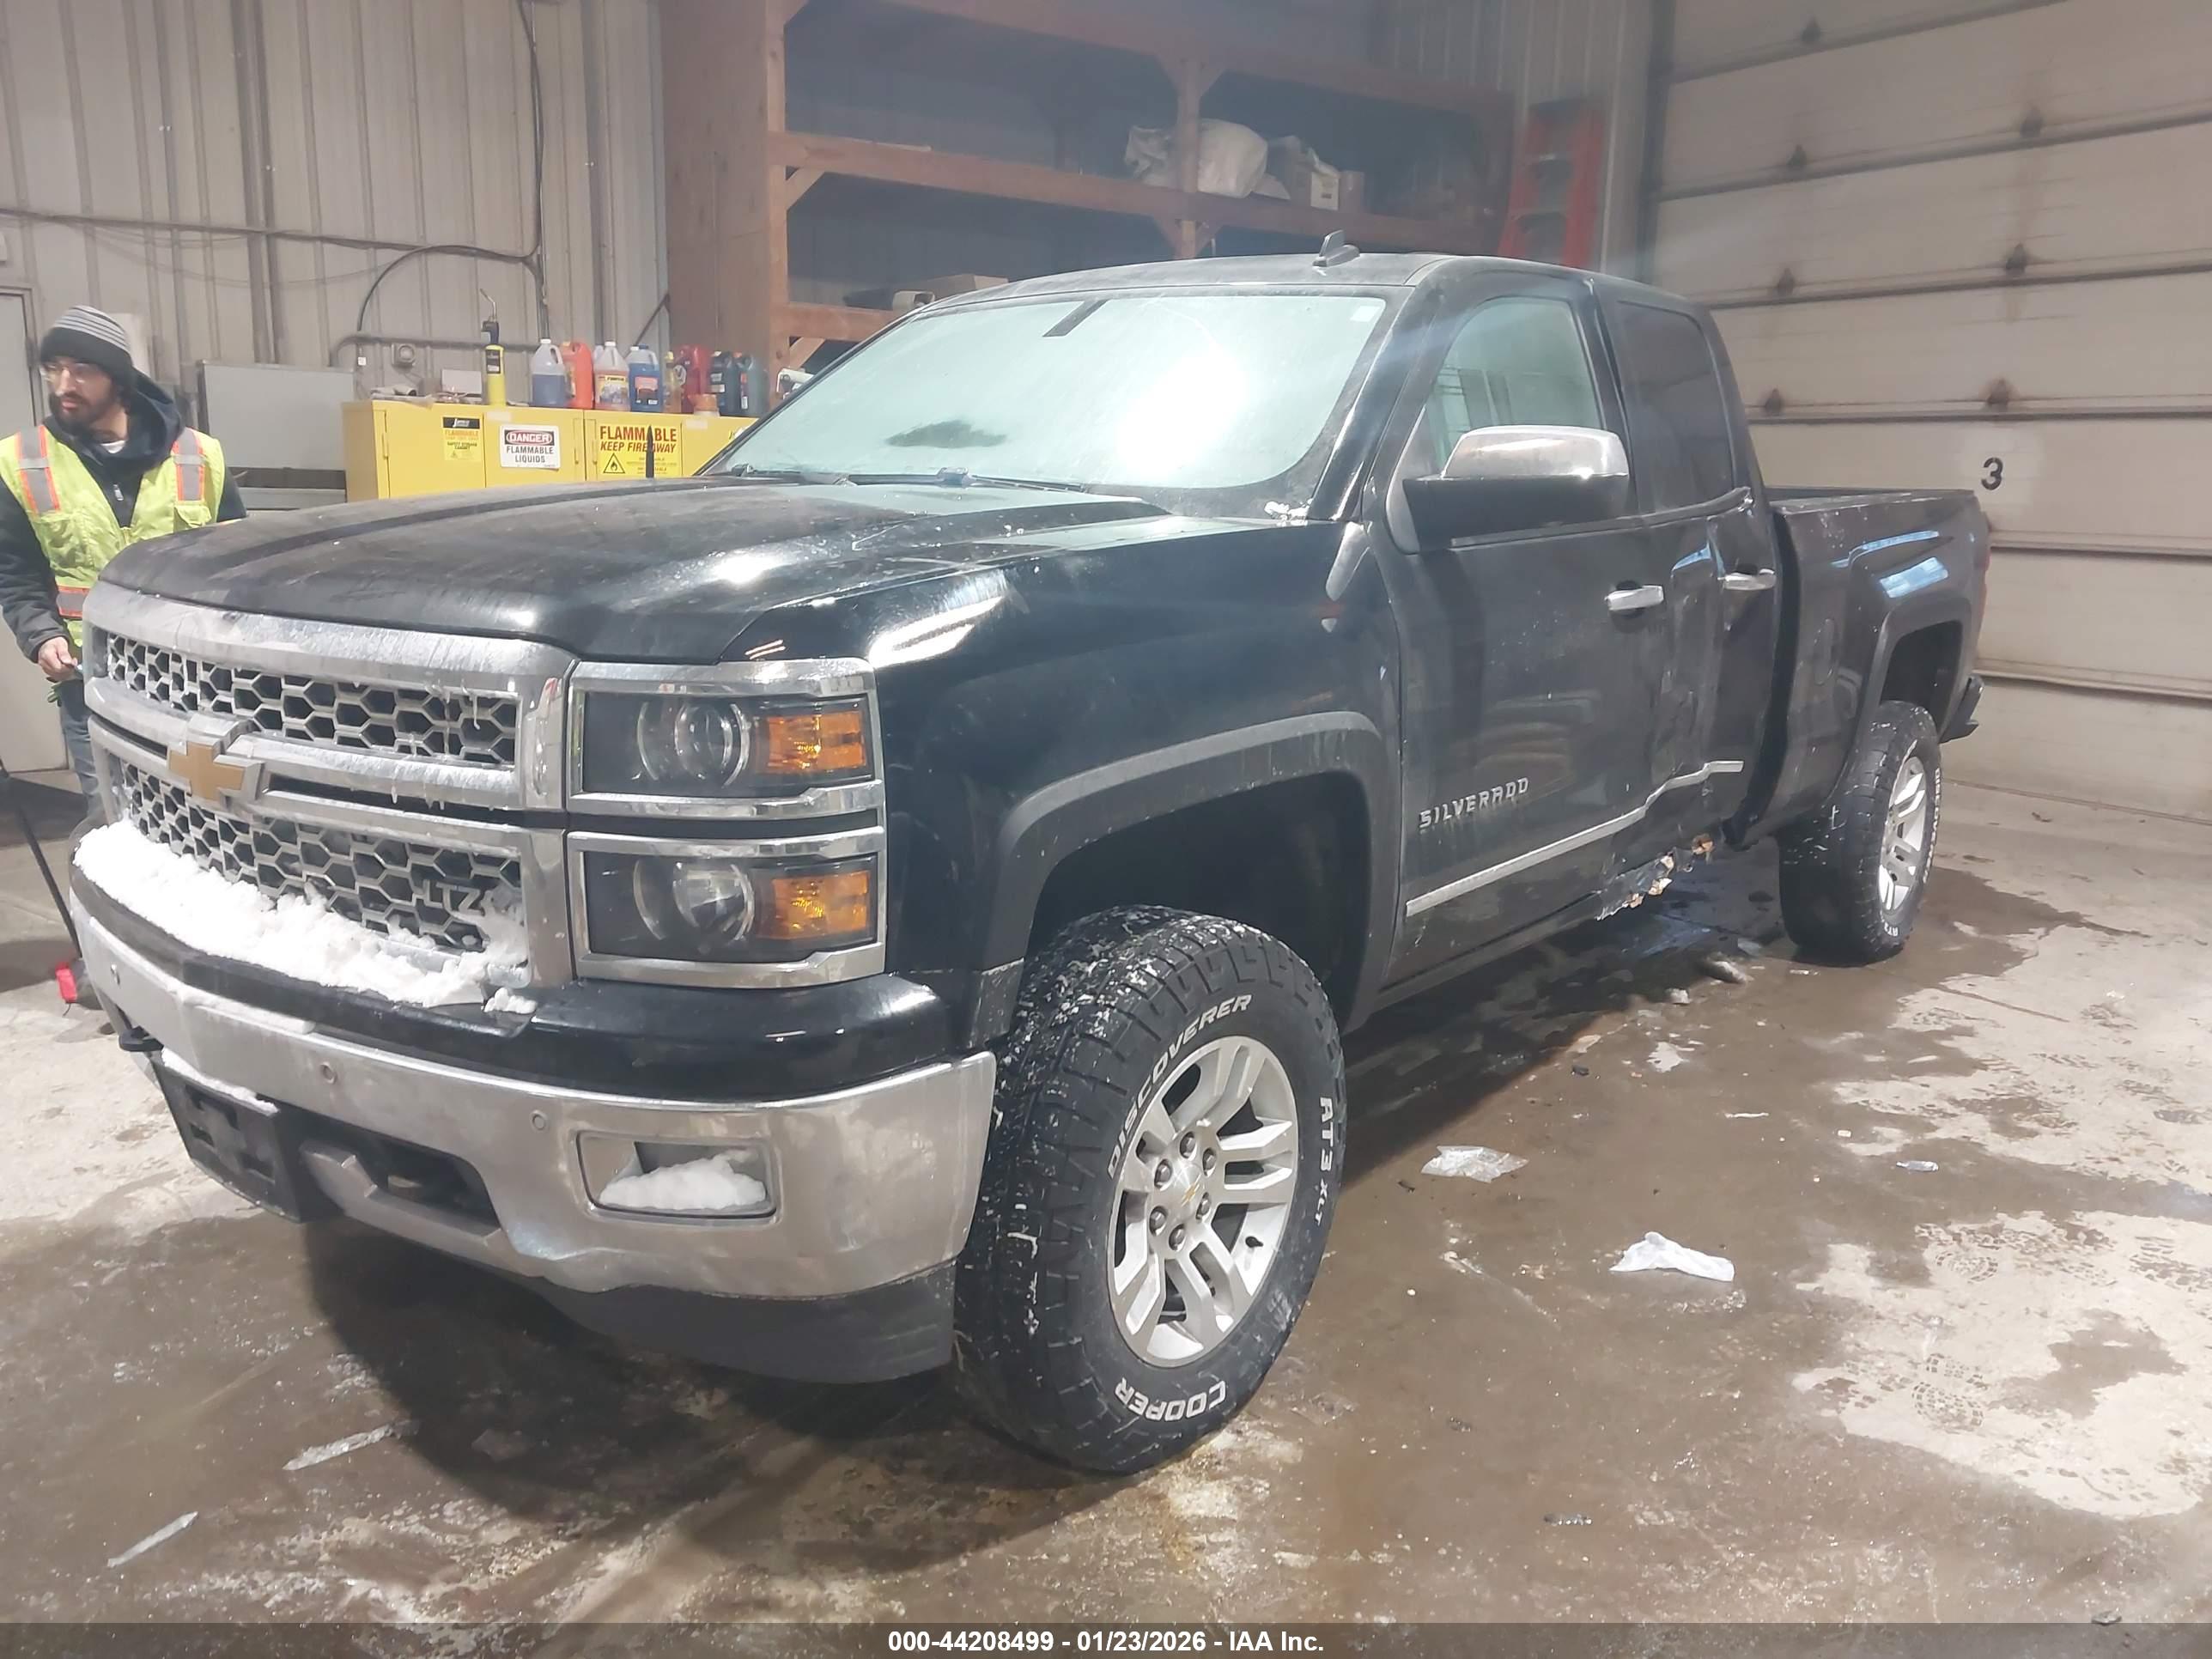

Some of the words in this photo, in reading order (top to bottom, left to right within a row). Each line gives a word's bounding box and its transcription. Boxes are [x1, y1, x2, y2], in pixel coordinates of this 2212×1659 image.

[509, 433, 550, 443] DANGER
[599, 425, 678, 442] FLAMMBLE
[506, 446, 555, 454] FLAMMABLE
[514, 455, 546, 464] LIQUIDS
[600, 441, 625, 452] KEEP
[627, 442, 648, 453] FIRE
[1980, 457, 2004, 491] 3
[1419, 777, 1529, 829] SILVERADO
[1107, 994, 1253, 1180] DISCOVERER
[1320, 1097, 1334, 1171] AT3
[1115, 1376, 1226, 1422] COOPER
